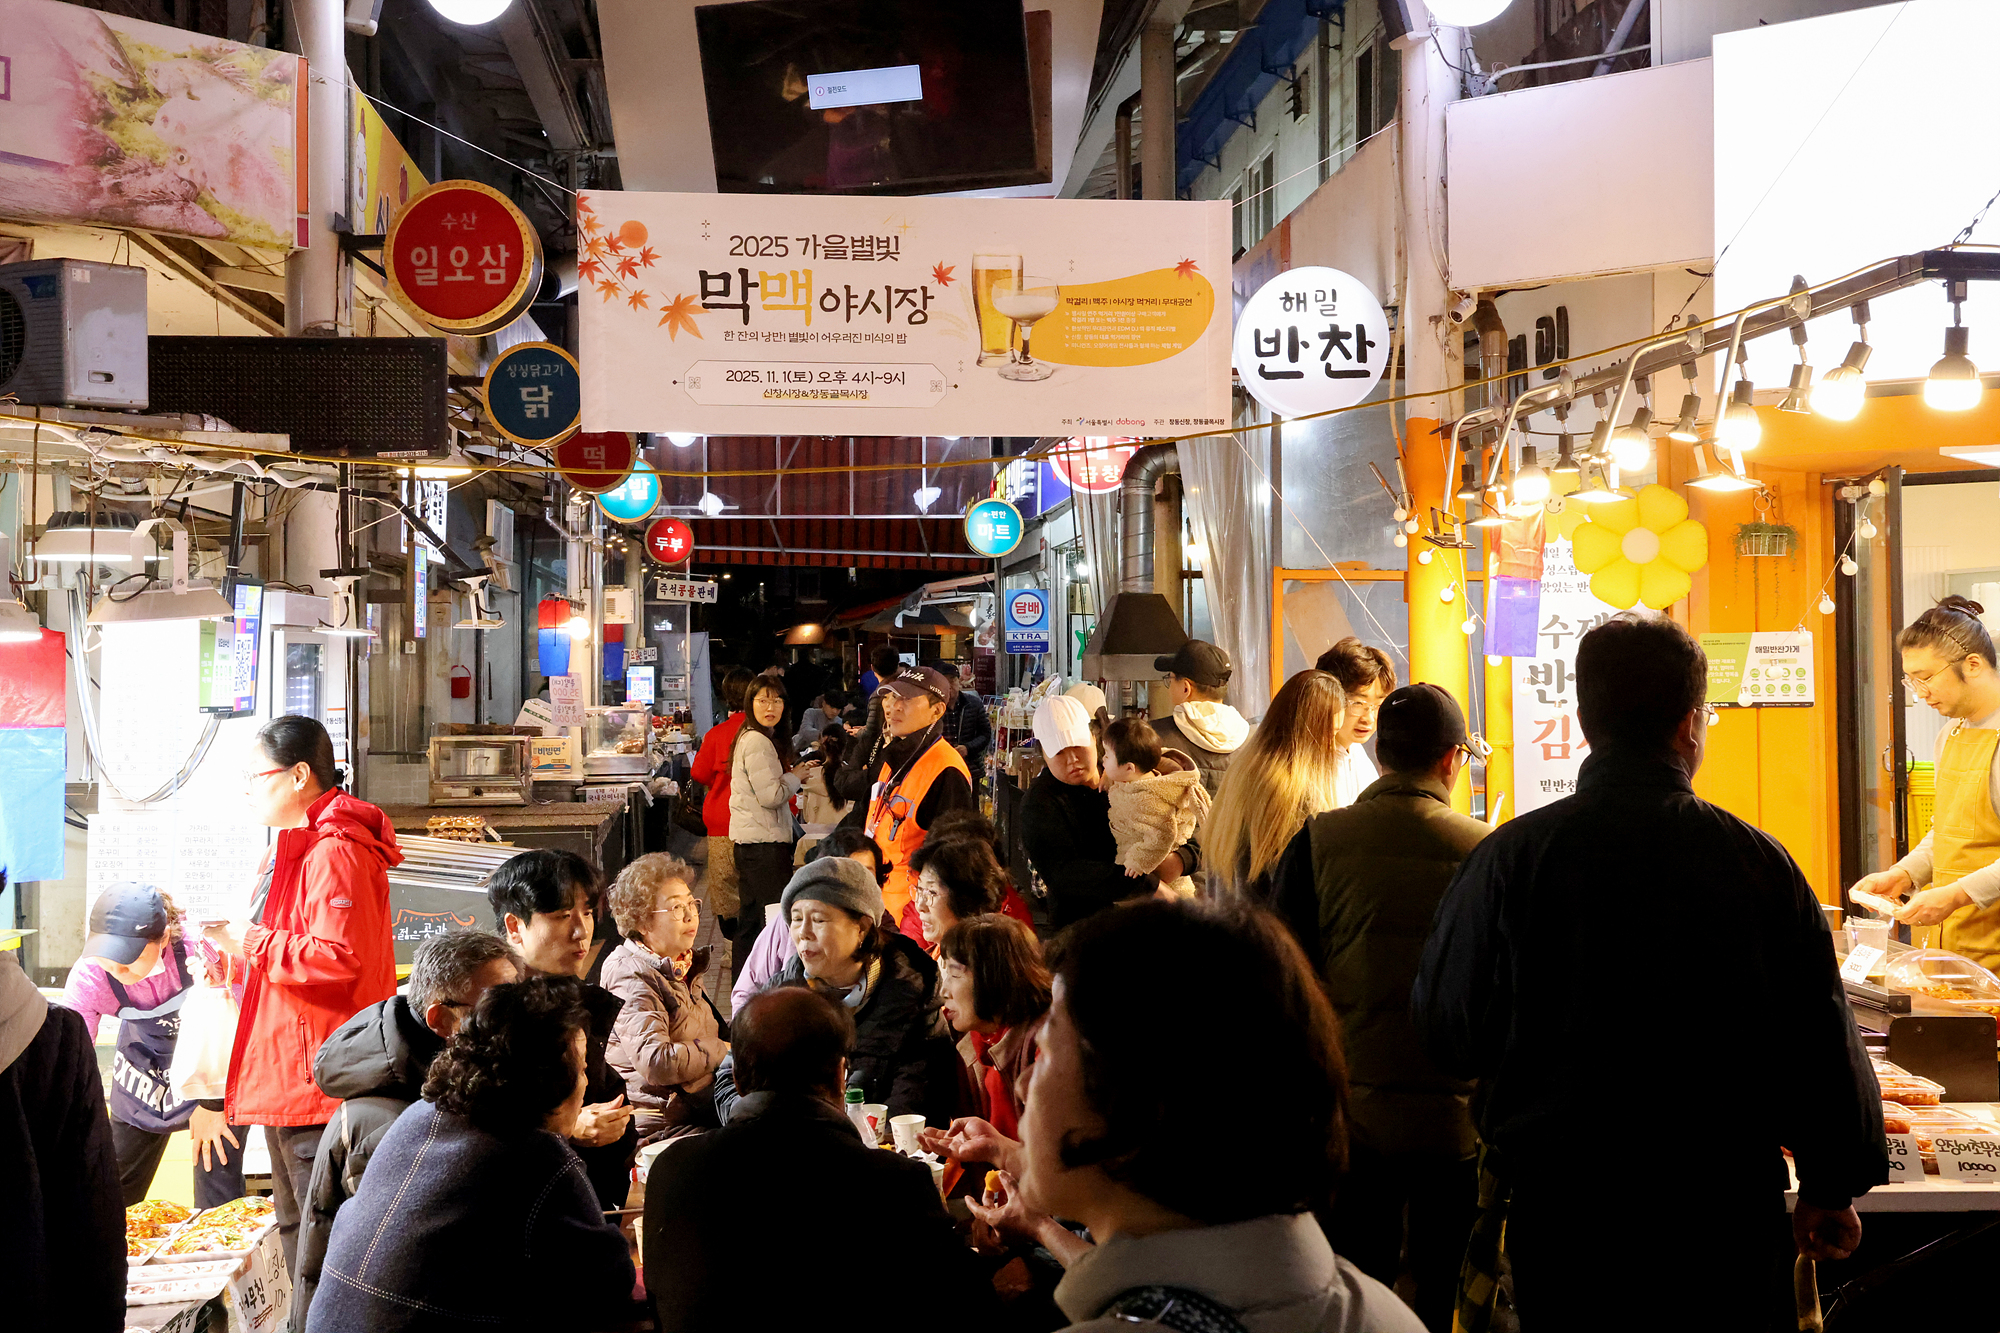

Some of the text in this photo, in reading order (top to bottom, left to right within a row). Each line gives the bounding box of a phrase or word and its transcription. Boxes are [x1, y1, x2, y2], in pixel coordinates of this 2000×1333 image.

[827, 85, 847, 94] 절전모드
[441, 212, 477, 230] 수산
[729, 234, 900, 261] 2025 가을별빛
[410, 244, 510, 286] 일오삼
[699, 268, 934, 326] 막맥 야시장
[1113, 298, 1135, 306] 야시장
[1137, 298, 1157, 306] 먹거리
[1162, 298, 1192, 306] 무대공연
[1279, 289, 1338, 317] 해밀
[724, 331, 907, 344] 한 잔의 낭만! 별빛이 어우러진 미식의 밤
[1254, 323, 1376, 380] 반찬
[506, 363, 564, 378] 싱싱닭고기
[726, 370, 905, 385] 2025. 11. 1(토) 오후 4시~9시
[519, 385, 553, 419] 닭
[763, 389, 868, 399] 신창시장&창동골목시장
[1116, 418, 1145, 426] dobong
[582, 445, 605, 471] 떡
[1079, 465, 1121, 484] 곱창
[667, 526, 674, 534] 손
[977, 524, 1011, 541] 마트
[655, 537, 683, 552] 두부
[1541, 582, 1573, 593] 맛있는
[1015, 602, 1039, 614] 담배
[1532, 714, 1590, 760] 김
[114, 1051, 165, 1112] EXTRA
